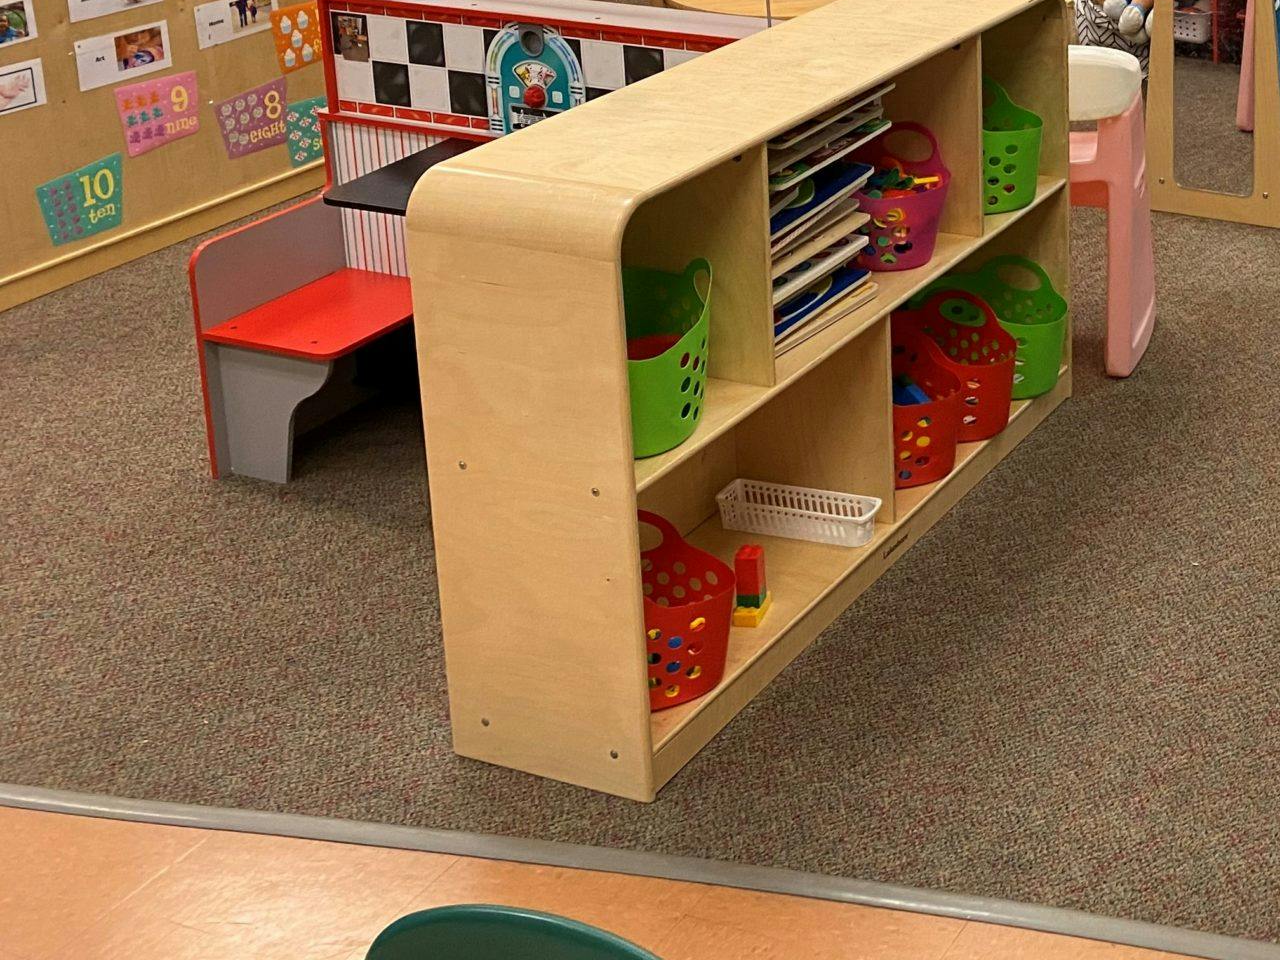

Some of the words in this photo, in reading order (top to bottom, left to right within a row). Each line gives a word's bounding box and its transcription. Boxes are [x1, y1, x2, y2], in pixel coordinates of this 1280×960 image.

[170, 85, 189, 112] 9
[264, 89, 282, 119] 8
[79, 168, 115, 208] 10
[88, 203, 116, 224] ten
